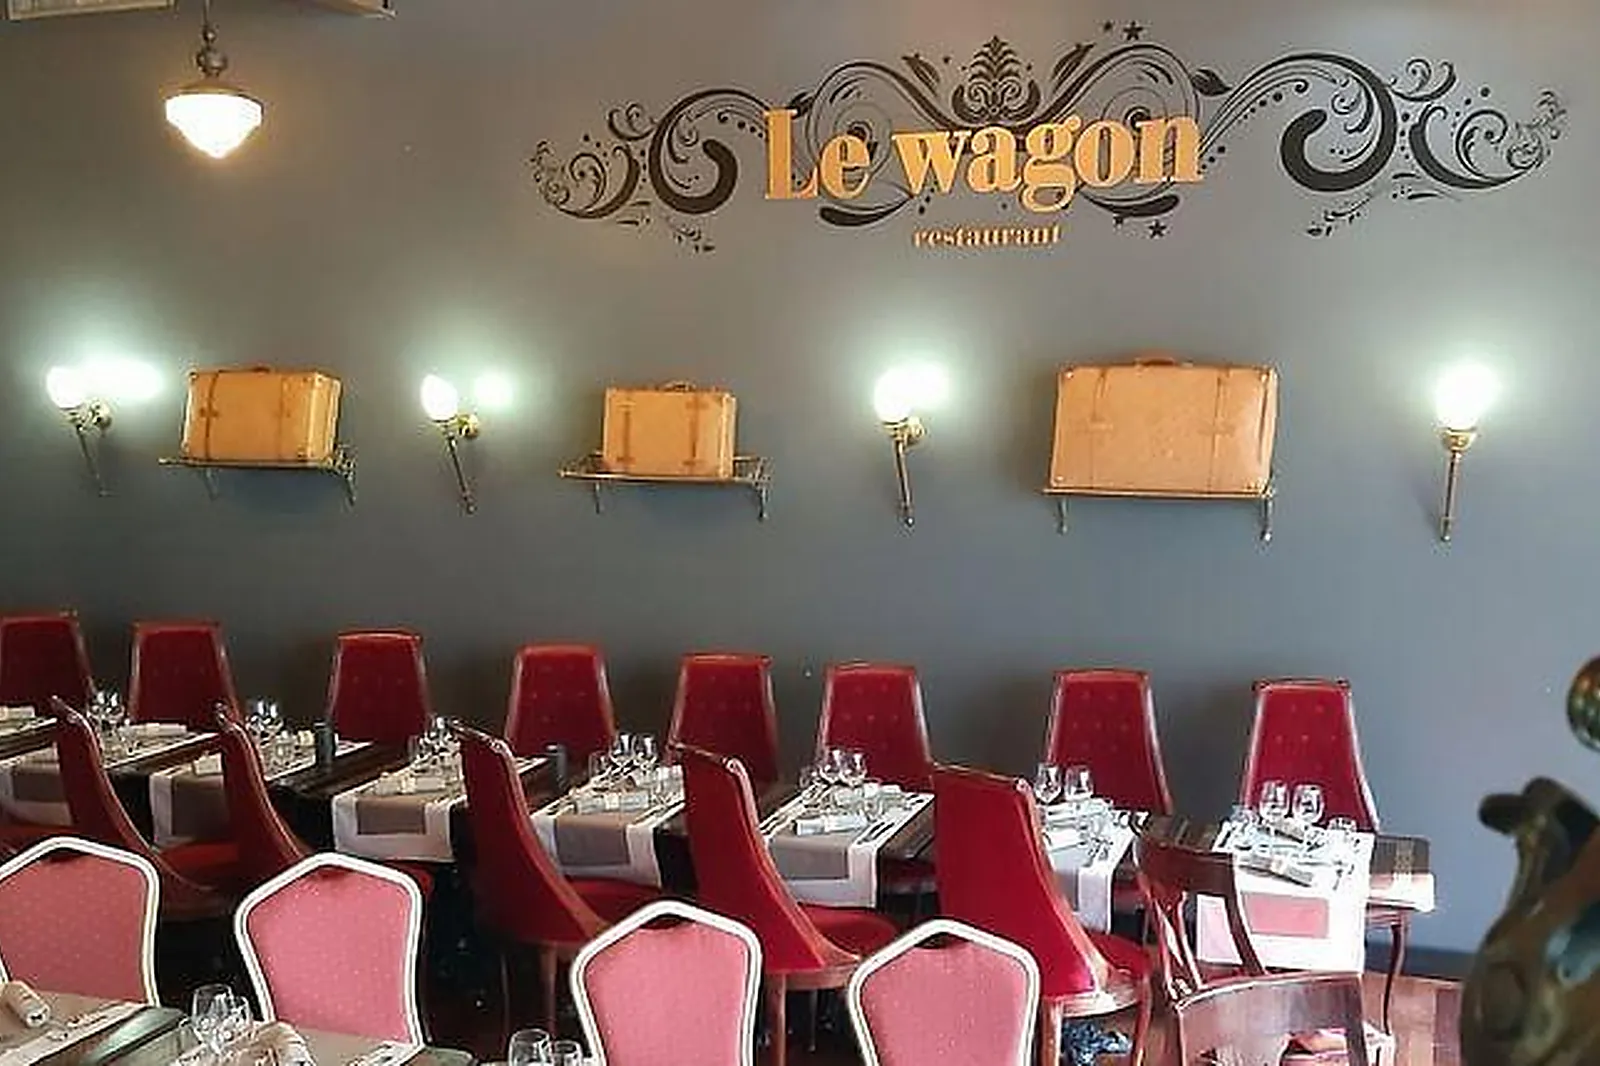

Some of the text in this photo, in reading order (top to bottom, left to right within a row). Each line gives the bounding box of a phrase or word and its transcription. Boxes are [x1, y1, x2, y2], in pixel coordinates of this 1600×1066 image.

[764, 108, 1204, 213] Le wagon
[913, 223, 1062, 248] restaurant
